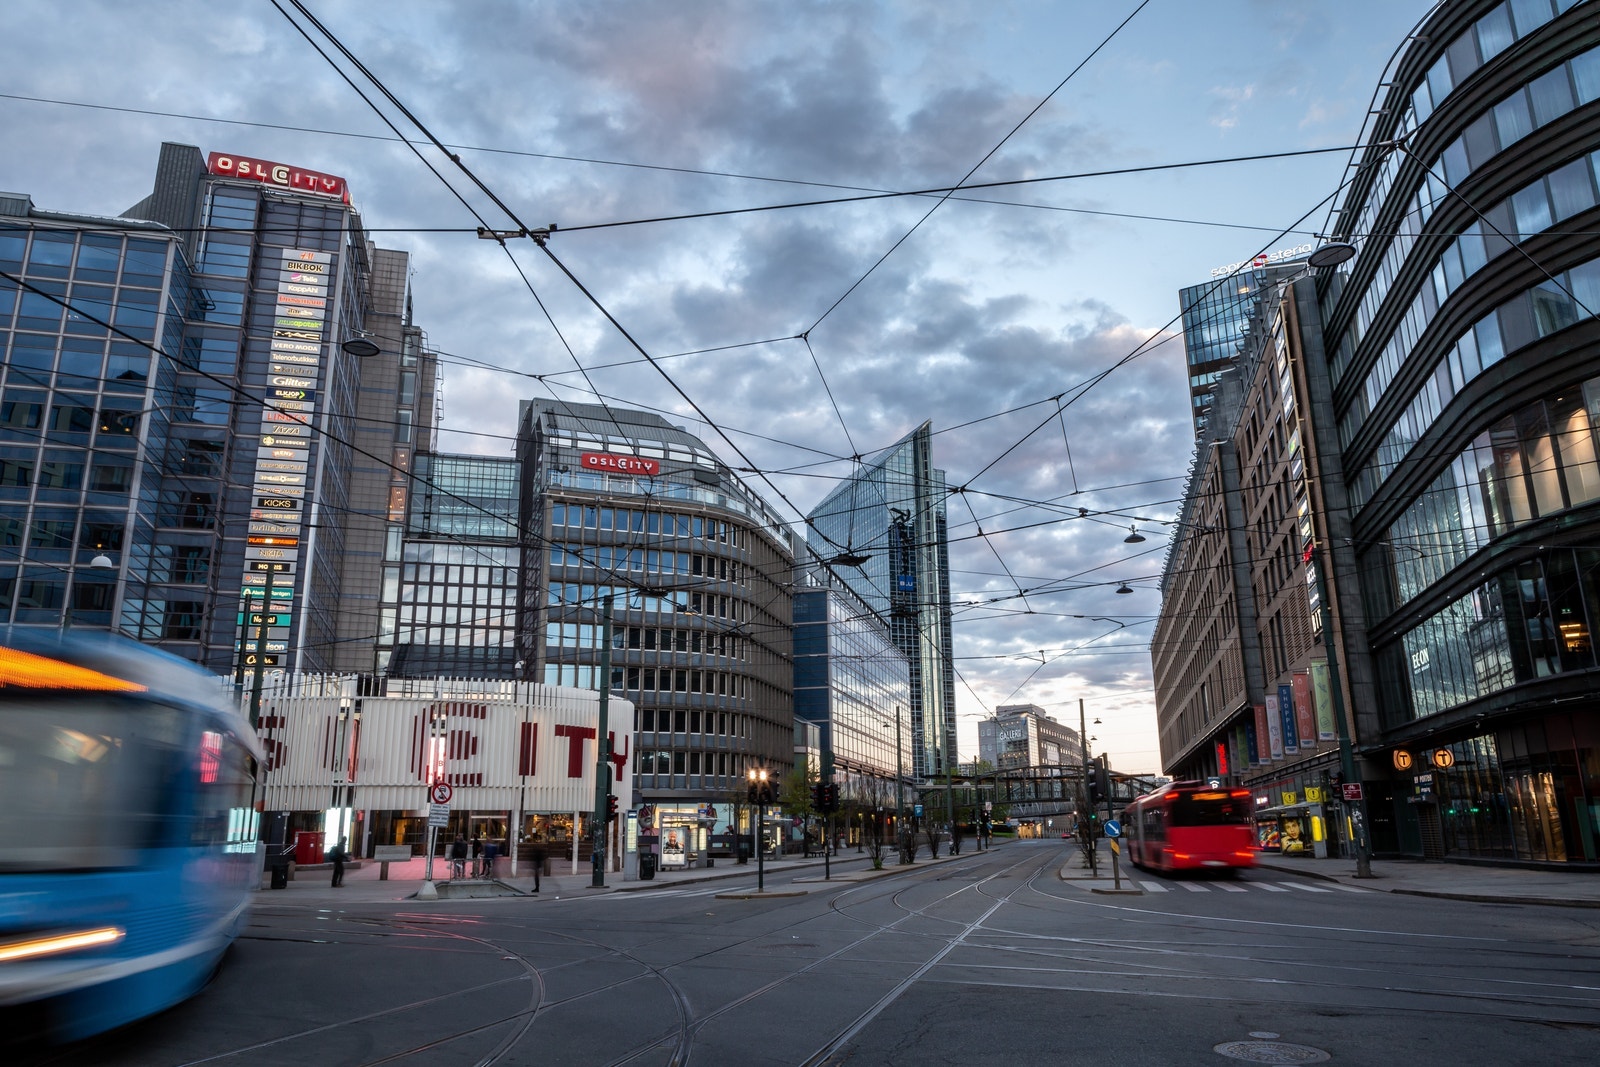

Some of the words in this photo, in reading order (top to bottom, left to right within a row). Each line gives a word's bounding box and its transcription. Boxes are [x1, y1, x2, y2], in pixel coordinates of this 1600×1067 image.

[1210, 260, 1252, 277] sopra
[1269, 243, 1312, 262] steria
[295, 344, 318, 352] MODA
[272, 377, 311, 387] Glitter
[263, 499, 291, 508] KICKS
[253, 615, 276, 623] Noal
[1282, 688, 1294, 745] SHOPPING
